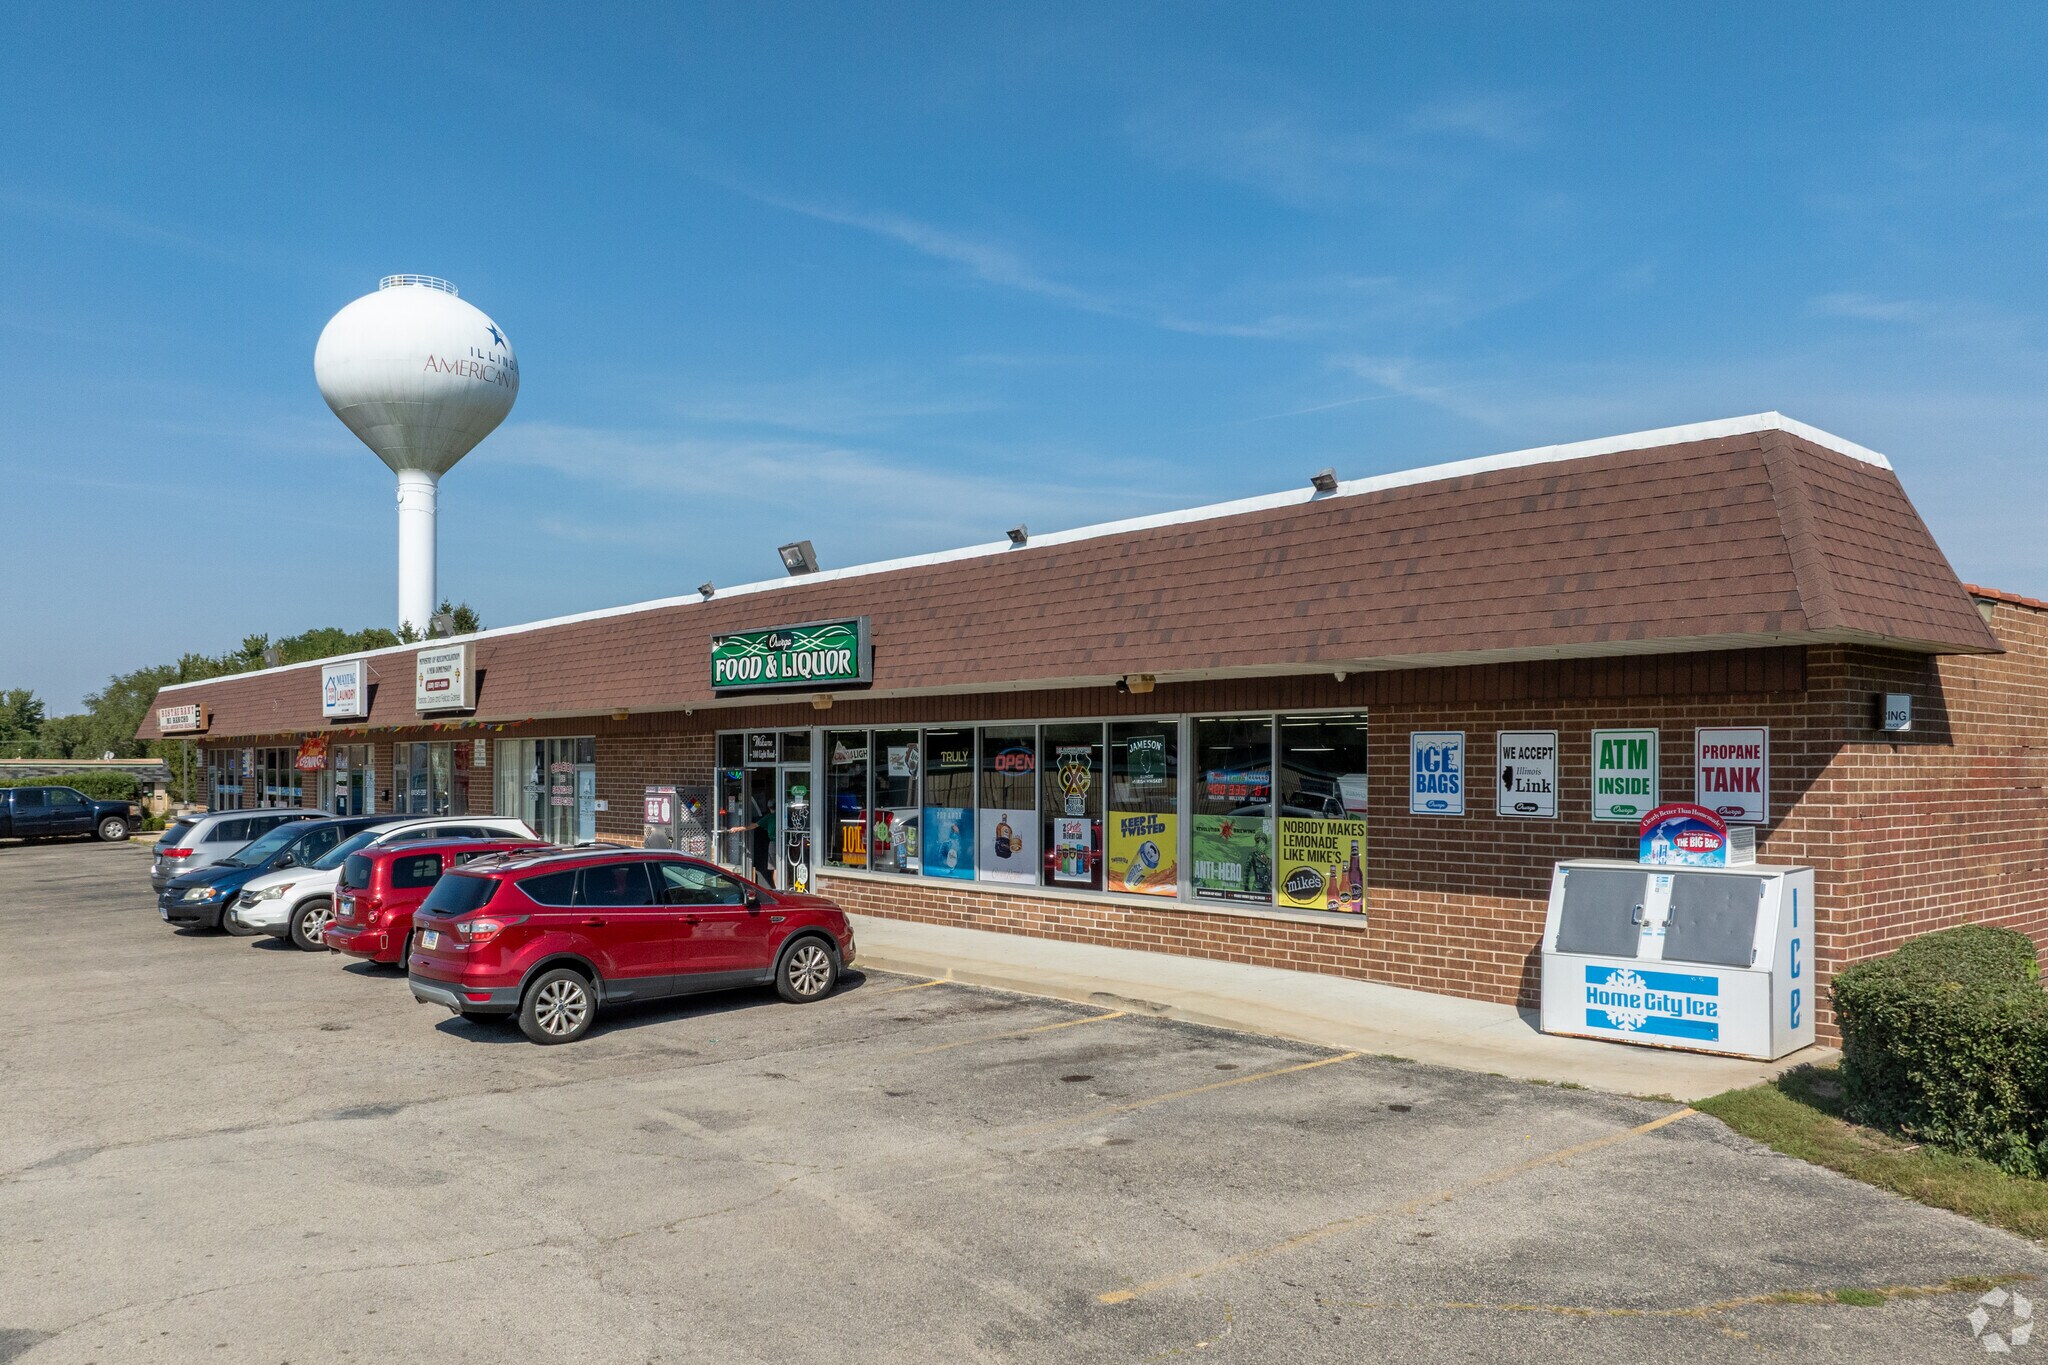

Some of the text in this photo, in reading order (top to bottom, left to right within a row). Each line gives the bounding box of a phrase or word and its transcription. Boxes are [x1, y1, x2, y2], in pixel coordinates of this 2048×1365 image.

[424, 354, 511, 388] AMERICAN
[768, 633, 792, 650] Oswego
[715, 649, 852, 682] FOOD & LIQUOR
[336, 689, 356, 701] LAUNDRY
[161, 706, 195, 718] RESTAURANT
[172, 715, 189, 724] RANCHO
[752, 735, 773, 747] Welcome
[1129, 739, 1162, 753] JAMESON
[853, 749, 868, 759] LIGH
[940, 751, 969, 763] TRULY
[1416, 741, 1459, 773] ICE
[1502, 746, 1554, 760] WE ACCEPT
[1599, 739, 1648, 770] ATM
[1702, 744, 1761, 760] PROPANE
[995, 753, 1035, 771] OPEN
[1516, 766, 1542, 776] Illinois
[1416, 773, 1459, 794] BAGS
[1515, 778, 1552, 794] Link
[1598, 777, 1650, 796] INSIDE
[1701, 766, 1761, 793] TANK
[1207, 783, 1227, 795] 400
[1427, 801, 1446, 809] Oswego
[1516, 803, 1536, 812] Oswego
[1612, 805, 1634, 815] Oswego
[1718, 806, 1743, 817] Oswego
[1120, 815, 1158, 829] KEEP IT
[1642, 813, 1660, 827] Clearly
[1659, 809, 1677, 817] Better
[1062, 823, 1067, 832] 2
[1121, 823, 1165, 838] TWISTED
[1283, 821, 1324, 835] NOBODY
[1327, 822, 1365, 837] MAKES
[1283, 835, 1339, 850] LEMONADE
[1676, 836, 1719, 848] THE BIG BAG
[1283, 848, 1342, 864] LIKE MIKE'S
[1194, 860, 1242, 882] ANTI-HERO
[1286, 875, 1322, 893] mike's
[1586, 986, 1718, 1018] Home City Ice
